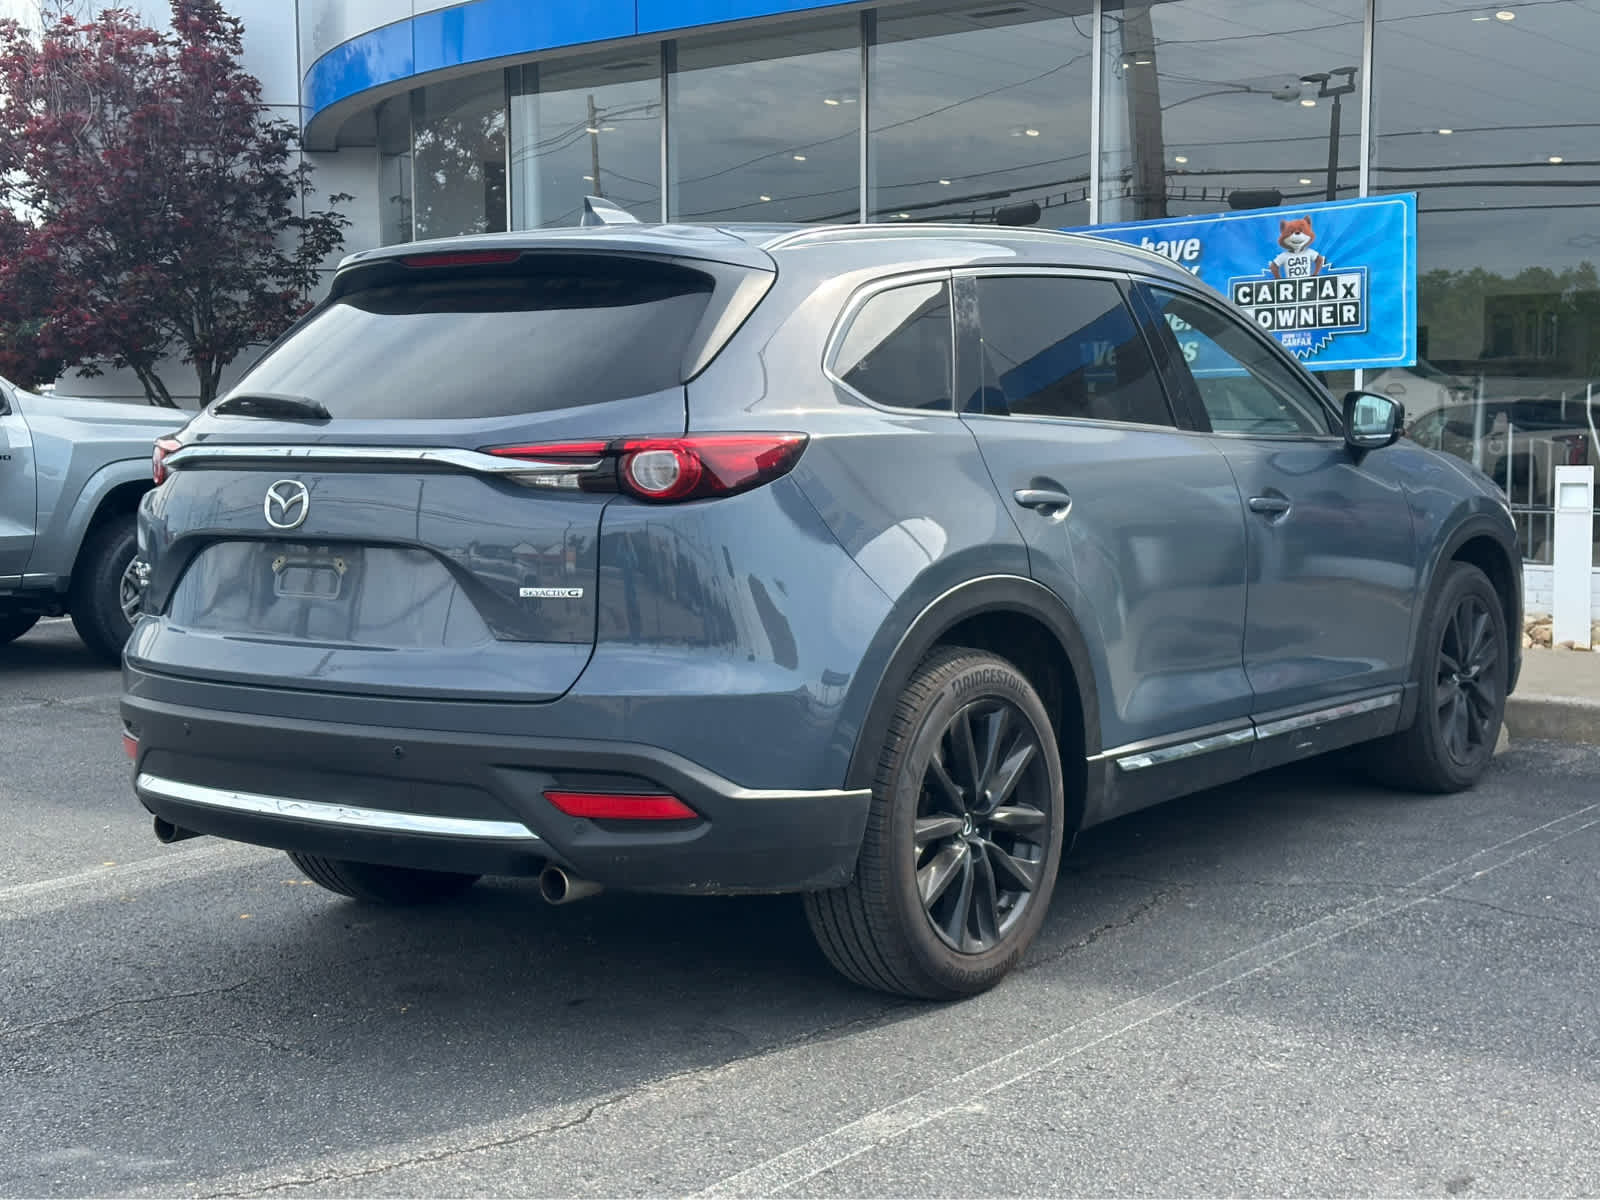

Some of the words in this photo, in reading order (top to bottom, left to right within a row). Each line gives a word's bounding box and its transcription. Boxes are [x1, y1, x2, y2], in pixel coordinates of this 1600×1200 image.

[1141, 237, 1200, 261] have
[1287, 256, 1308, 267] CAR
[1289, 266, 1308, 277] FOX
[1237, 279, 1356, 303] CARFAX
[1257, 304, 1356, 328] OWNER
[951, 669, 1030, 697] BRIDGESTONE
